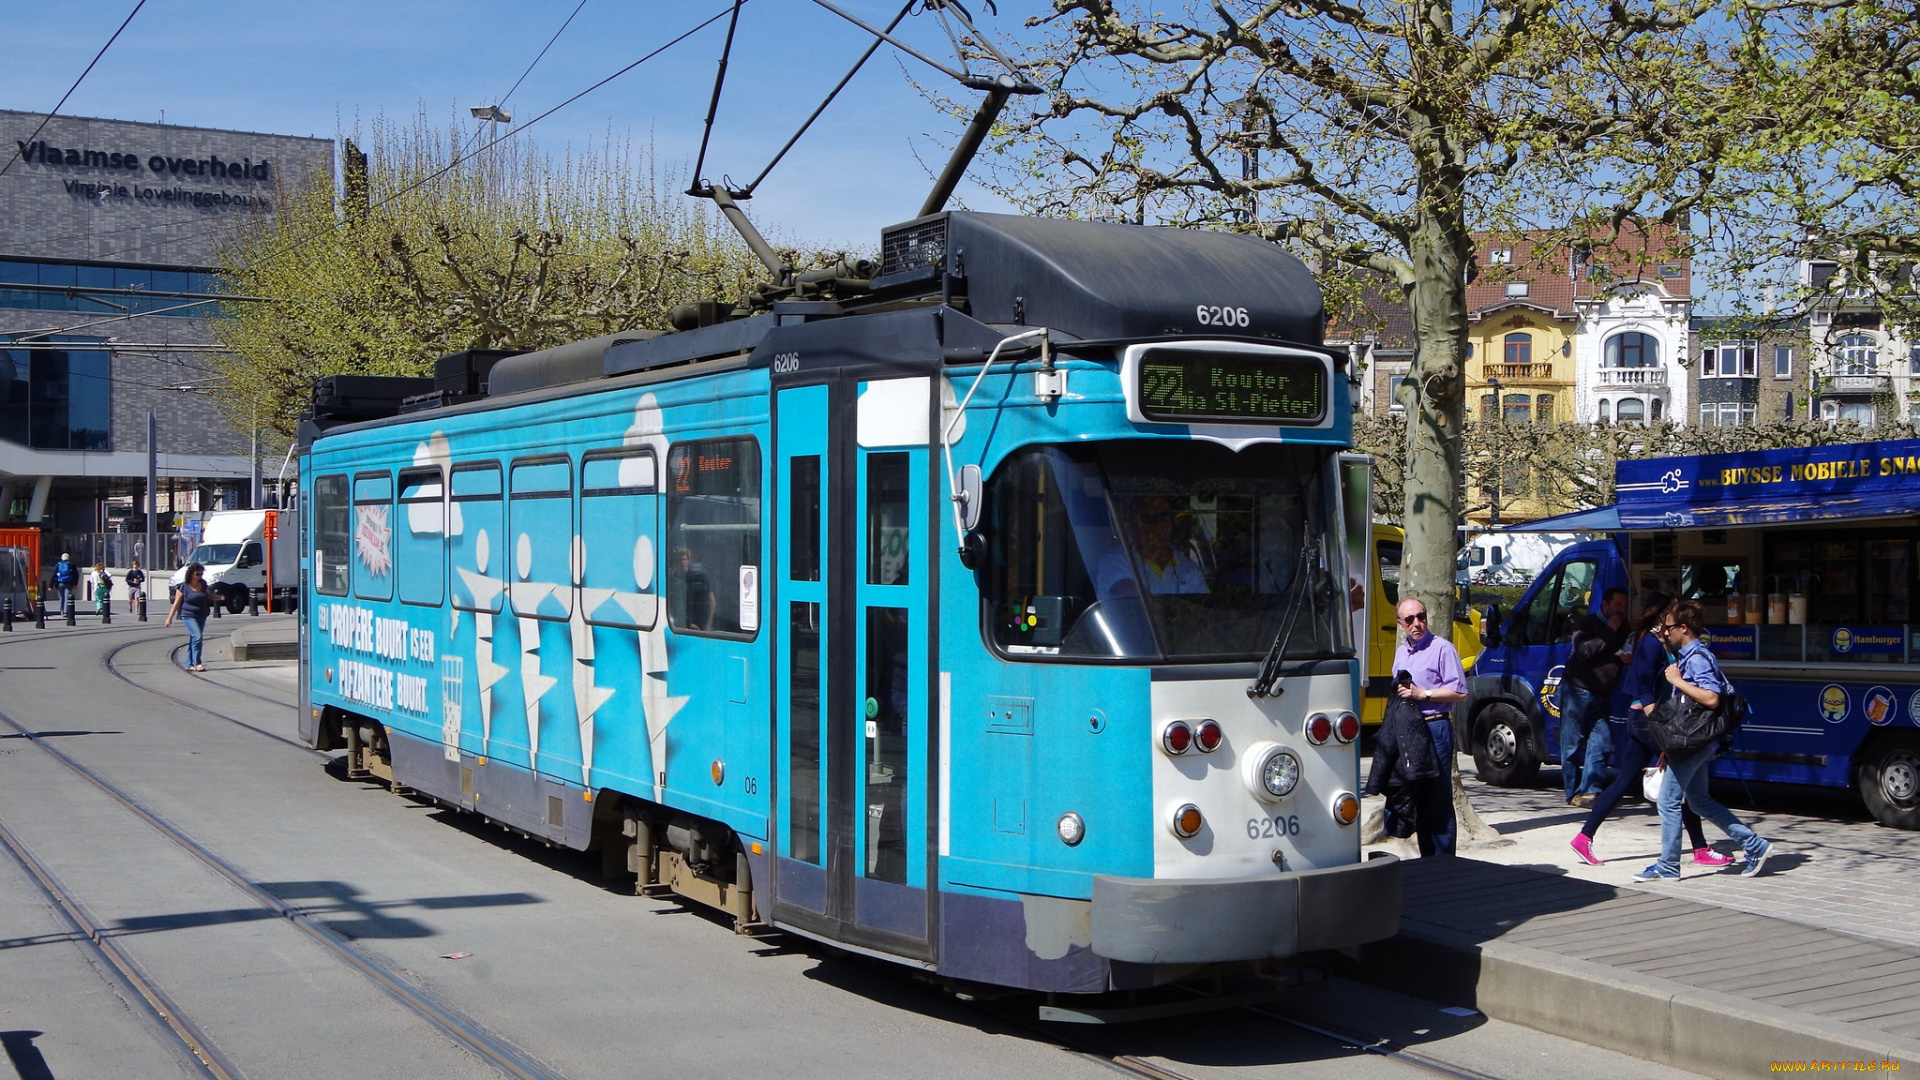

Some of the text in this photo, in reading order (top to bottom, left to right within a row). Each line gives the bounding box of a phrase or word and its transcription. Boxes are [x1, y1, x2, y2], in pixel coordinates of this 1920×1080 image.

[17, 140, 268, 181] Vlaamse overheid
[63, 179, 127, 199] Virginie
[1196, 304, 1250, 328] 6206
[774, 352, 799, 373] 6206
[1211, 367, 1290, 390] Kouter
[676, 455, 732, 491] 22 Kouter
[1790, 459, 1871, 481] MOBIELE
[331, 604, 373, 652] PROPERE
[376, 617, 408, 660] BUURT
[410, 627, 419, 659] IS
[420, 629, 434, 662] EEN
[1711, 634, 1753, 644] Braadworst
[1854, 634, 1902, 646] Hamburger
[339, 658, 393, 709] PLEZANTERE
[745, 777, 757, 795] 06
[1247, 815, 1300, 839] 6206
